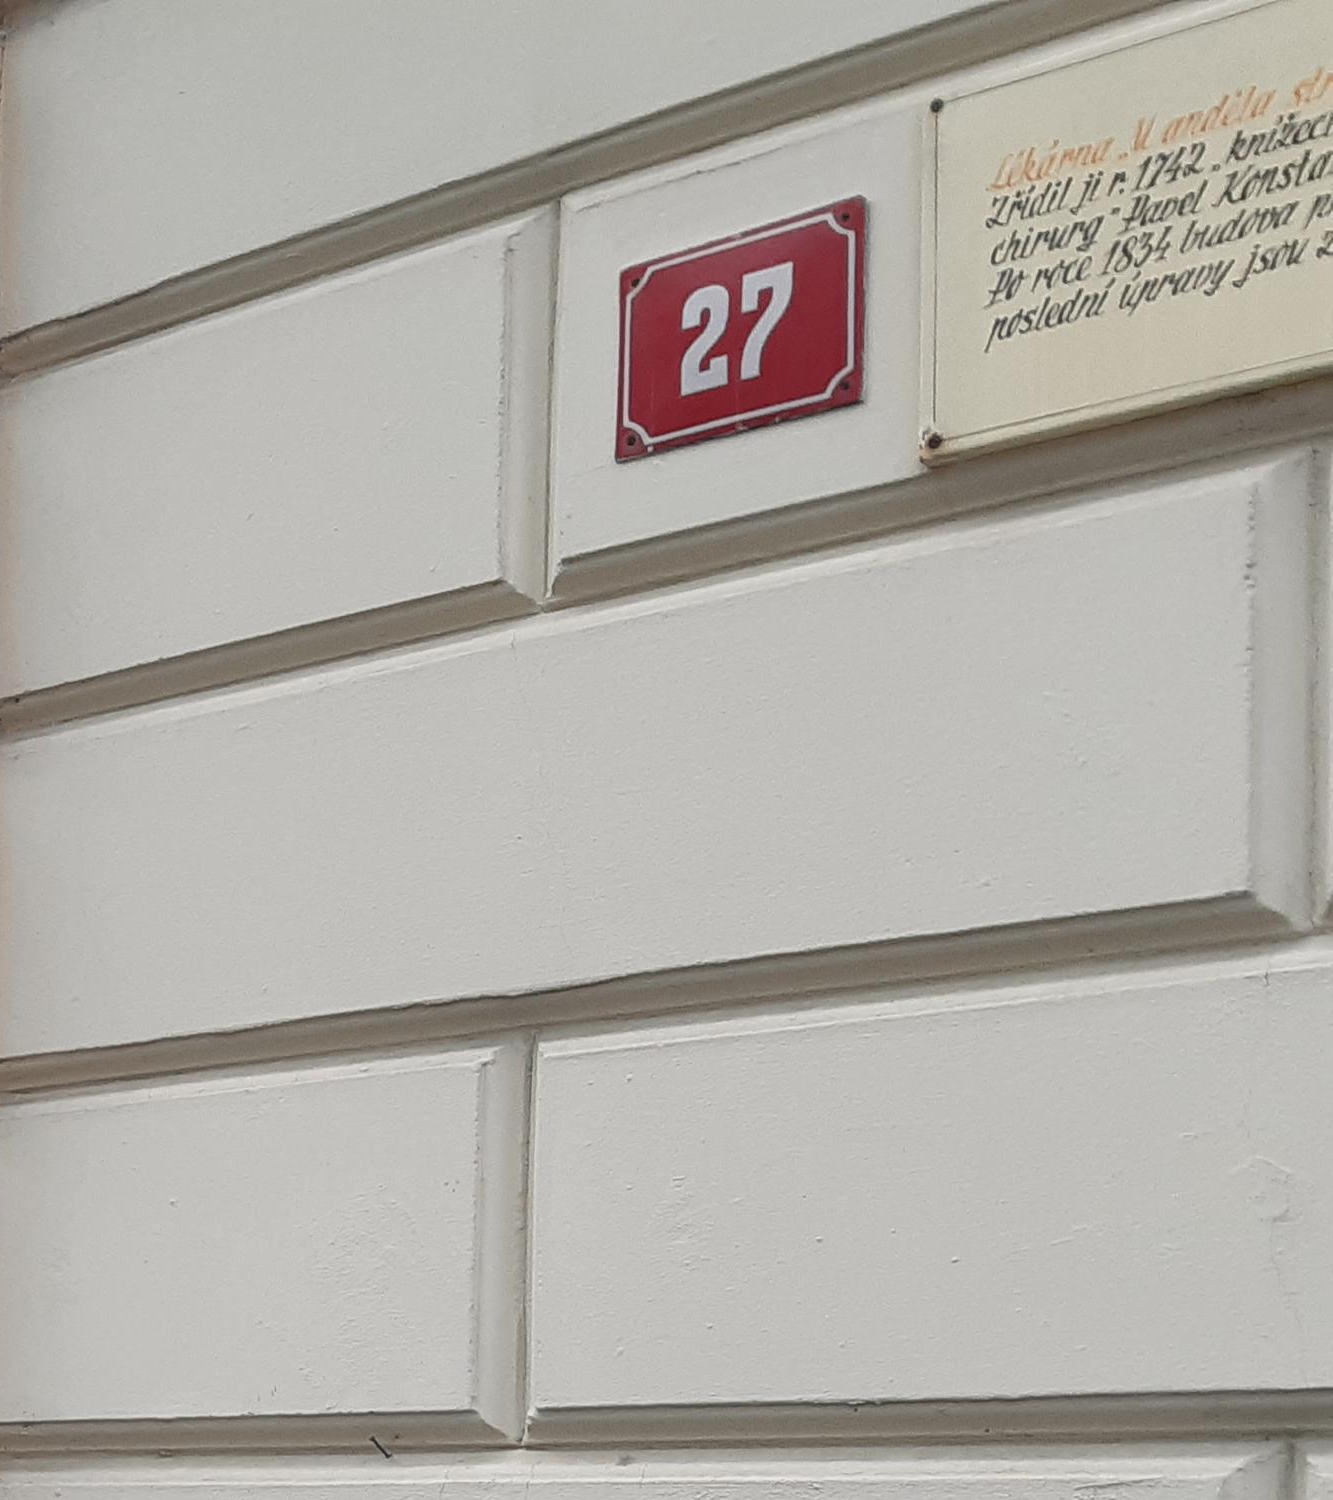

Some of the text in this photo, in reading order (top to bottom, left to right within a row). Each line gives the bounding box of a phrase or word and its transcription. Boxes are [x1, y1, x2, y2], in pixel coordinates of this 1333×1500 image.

[1117, 180, 1208, 236] Pavel
[1211, 148, 1333, 208] Konsta
[1132, 141, 1207, 193] 1742
[982, 276, 1117, 354] poslední
[1118, 258, 1236, 316] úpravy
[1233, 238, 1310, 288] jsou
[983, 266, 1027, 310] Po
[1031, 255, 1093, 293] roce
[1096, 225, 1174, 276] 1834
[1180, 200, 1300, 254] budova
[679, 261, 795, 398] 27
